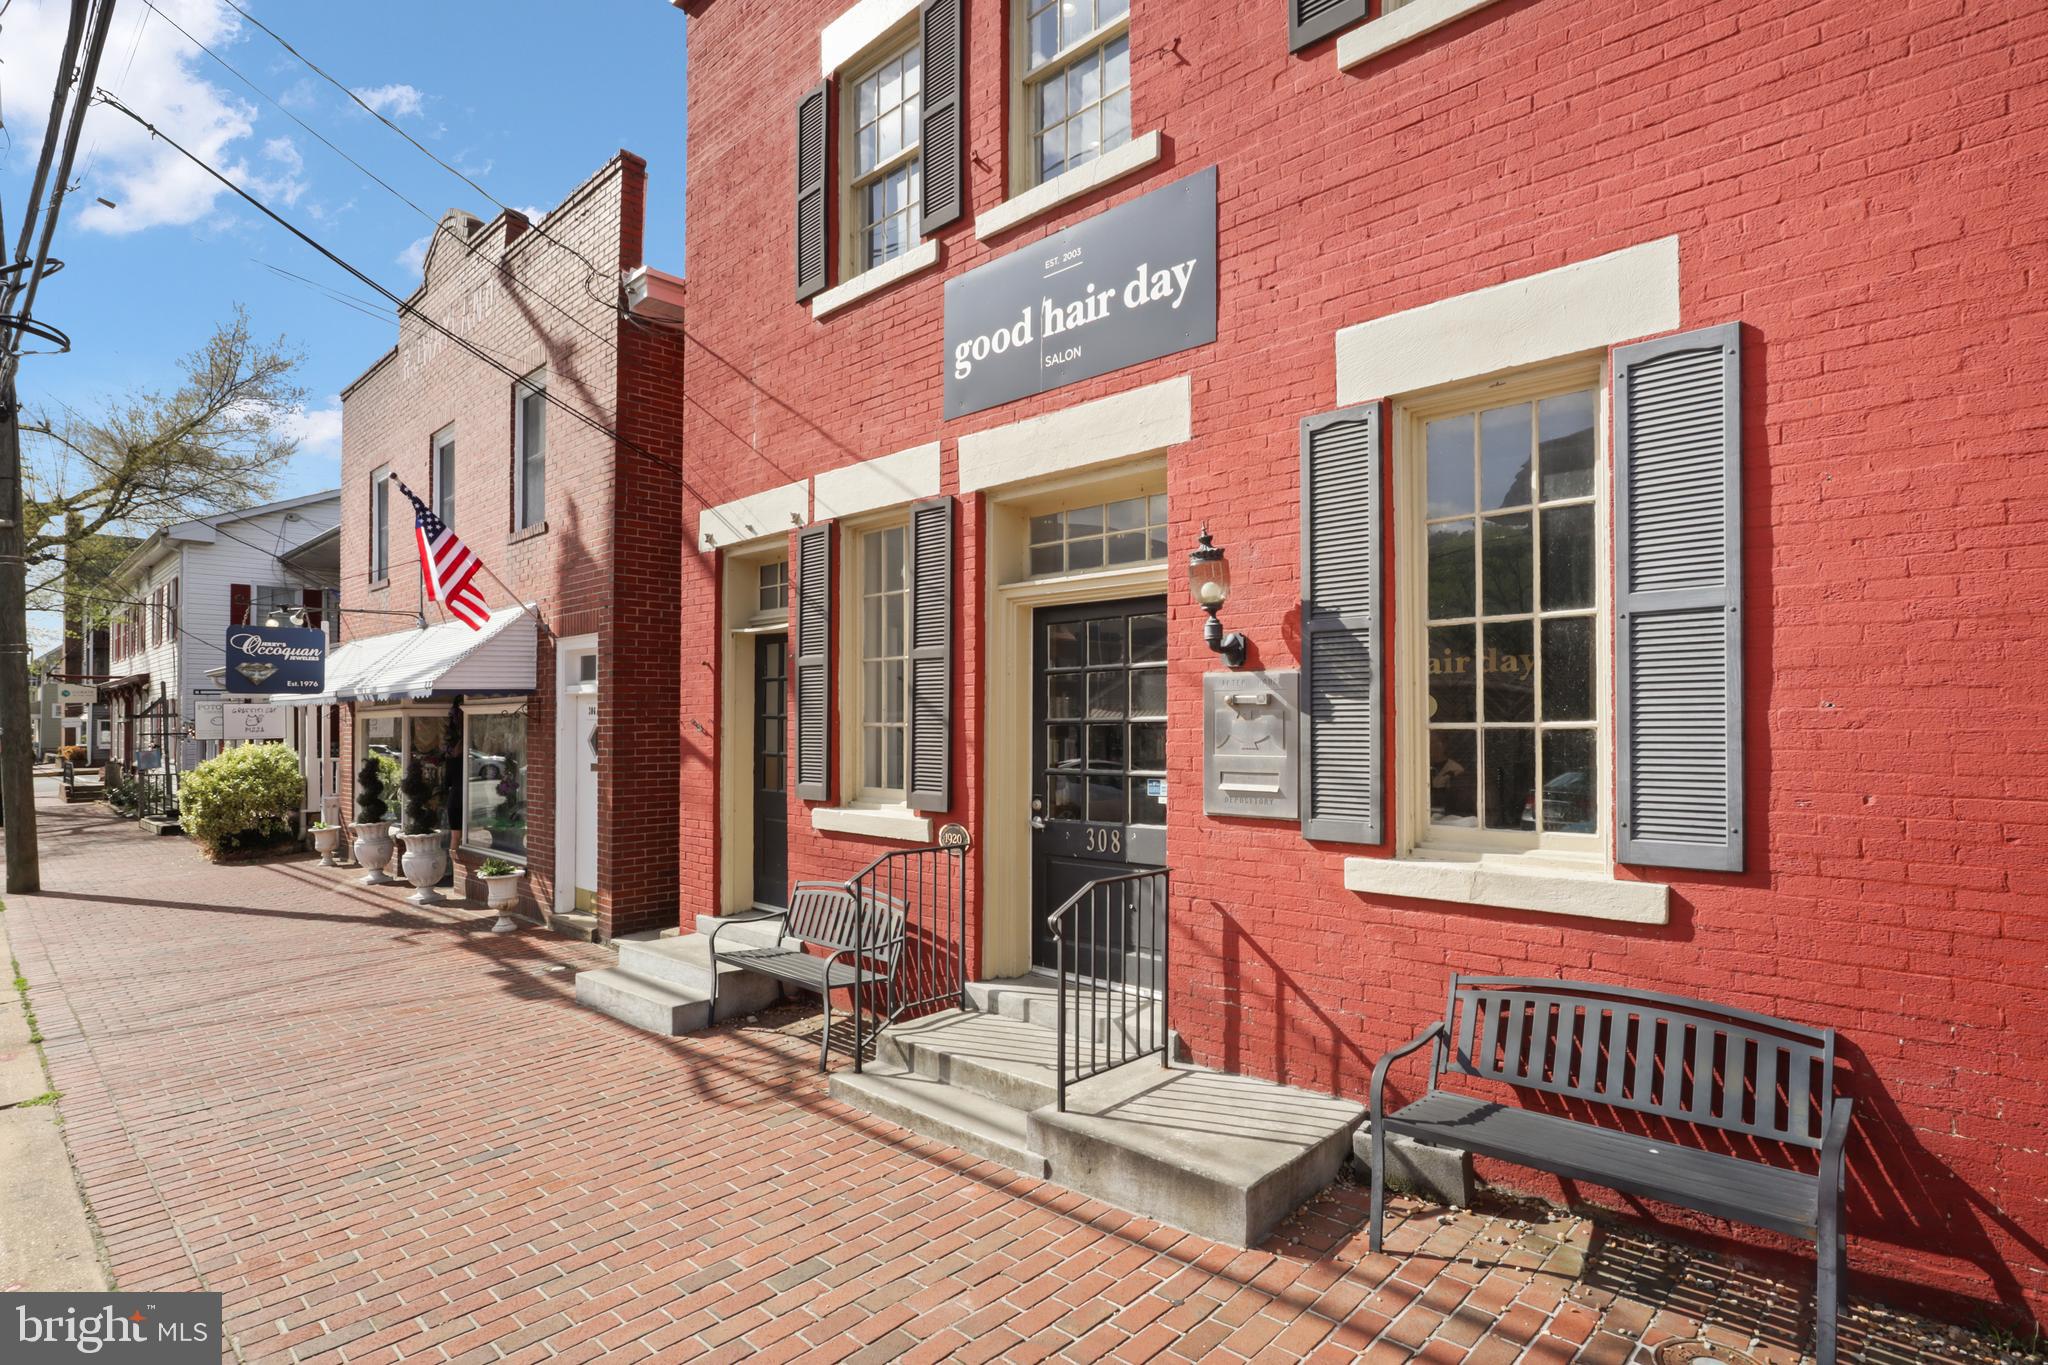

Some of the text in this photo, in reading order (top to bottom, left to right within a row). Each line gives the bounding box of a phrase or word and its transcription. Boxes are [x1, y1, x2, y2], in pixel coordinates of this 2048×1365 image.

[1044, 247, 1082, 270] EST. 2003
[954, 258, 1197, 380] good hair day
[1045, 345, 1082, 368] SALON
[230, 633, 322, 660] Occoquan
[1428, 647, 1535, 681] air day
[945, 833, 962, 846] 1920
[1086, 828, 1121, 853] 308
